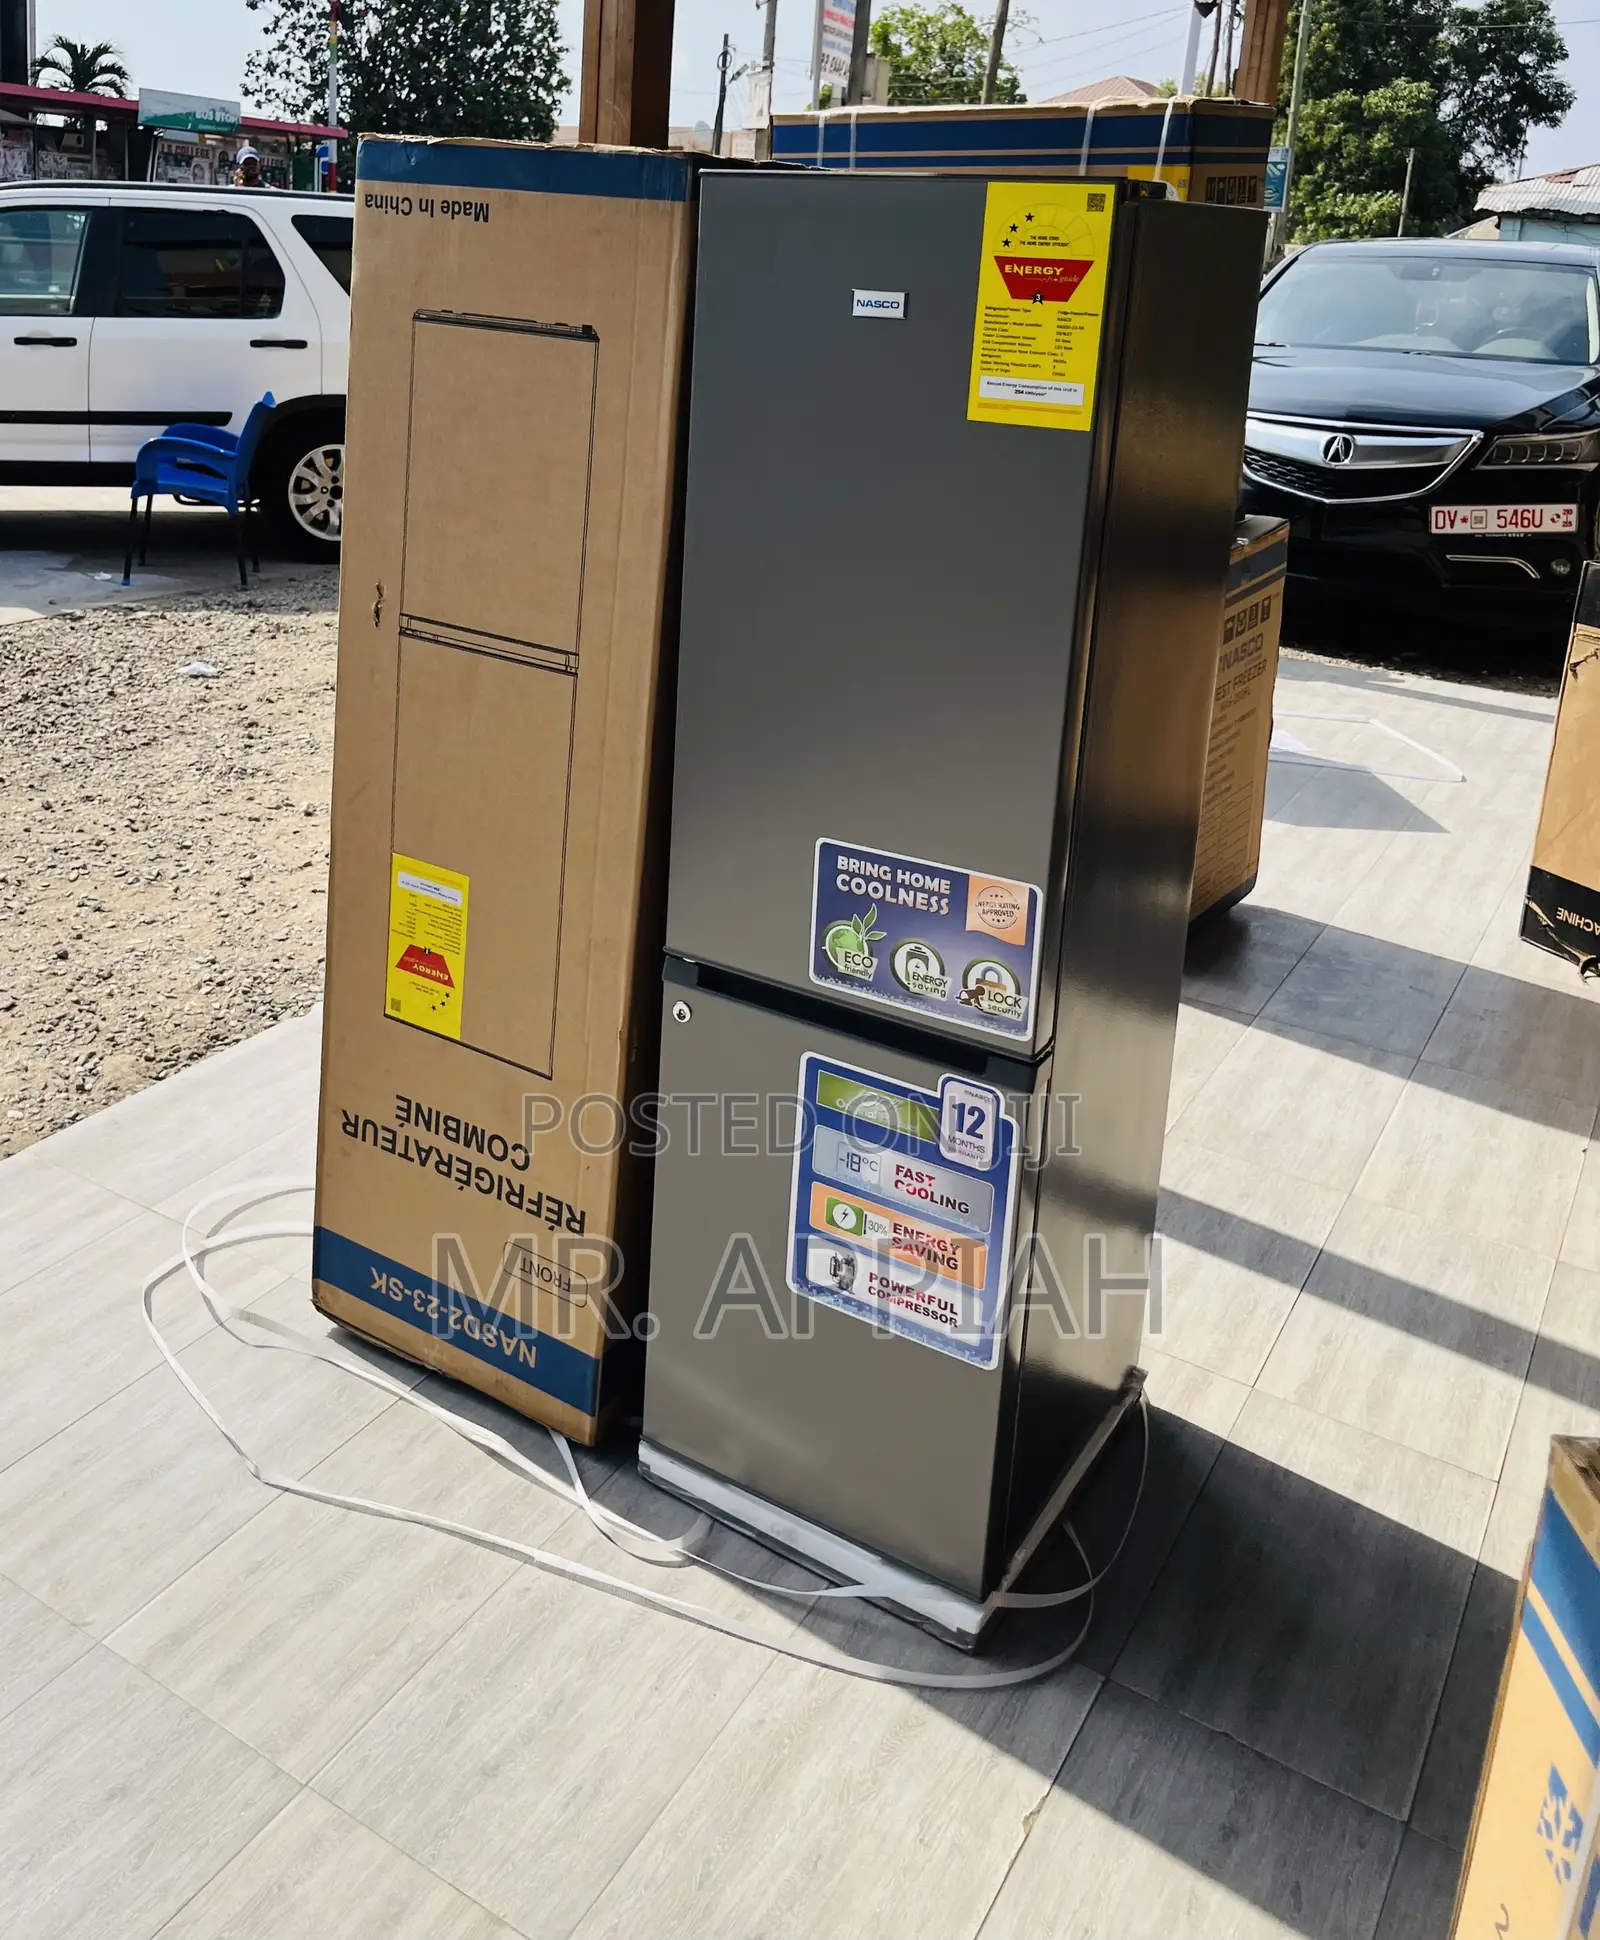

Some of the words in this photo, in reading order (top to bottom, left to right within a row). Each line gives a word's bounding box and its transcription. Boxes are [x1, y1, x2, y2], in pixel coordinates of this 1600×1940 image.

[195, 109, 213, 120] BUS
[364, 193, 413, 216] China
[419, 198, 435, 218] In
[441, 199, 490, 223] Made
[1004, 263, 1064, 276] ENERGY
[856, 299, 900, 309] NASCO
[1036, 293, 1041, 301] 3
[1435, 510, 1458, 530] DV
[1497, 508, 1544, 529] 546U
[1221, 632, 1264, 673] NASCO
[1215, 680, 1233, 702] EST
[1233, 658, 1267, 696] FREEZER
[837, 855, 891, 882] BRING
[896, 869, 950, 895] HOME
[836, 873, 950, 916] COOLNESS
[982, 908, 1015, 918] APPROVED
[1556, 906, 1600, 936] ACHINE
[844, 951, 873, 969] ECO
[412, 963, 449, 982] ENERGY
[843, 964, 873, 980] friendly
[912, 971, 948, 989] ENERGY
[912, 982, 947, 998] saving
[988, 989, 1022, 1008] LOCK
[987, 1003, 1022, 1019] security
[395, 1093, 530, 1171] COMBINÉ
[952, 1102, 986, 1140] 12
[948, 1135, 985, 1154] MONTHS
[341, 1109, 586, 1237] RÉFRIGÉRATEUR
[895, 1164, 936, 1187] FAST
[894, 1179, 970, 1215] COOLING
[867, 1220, 888, 1237] 30%
[892, 1222, 960, 1256] ENERGY
[891, 1236, 959, 1271] SAVING
[519, 1256, 572, 1292] FRONT
[869, 1272, 959, 1316] POWERFUL
[370, 1266, 537, 1369] NASD2-23-SK
[868, 1286, 958, 1328] COMPRESSOR
